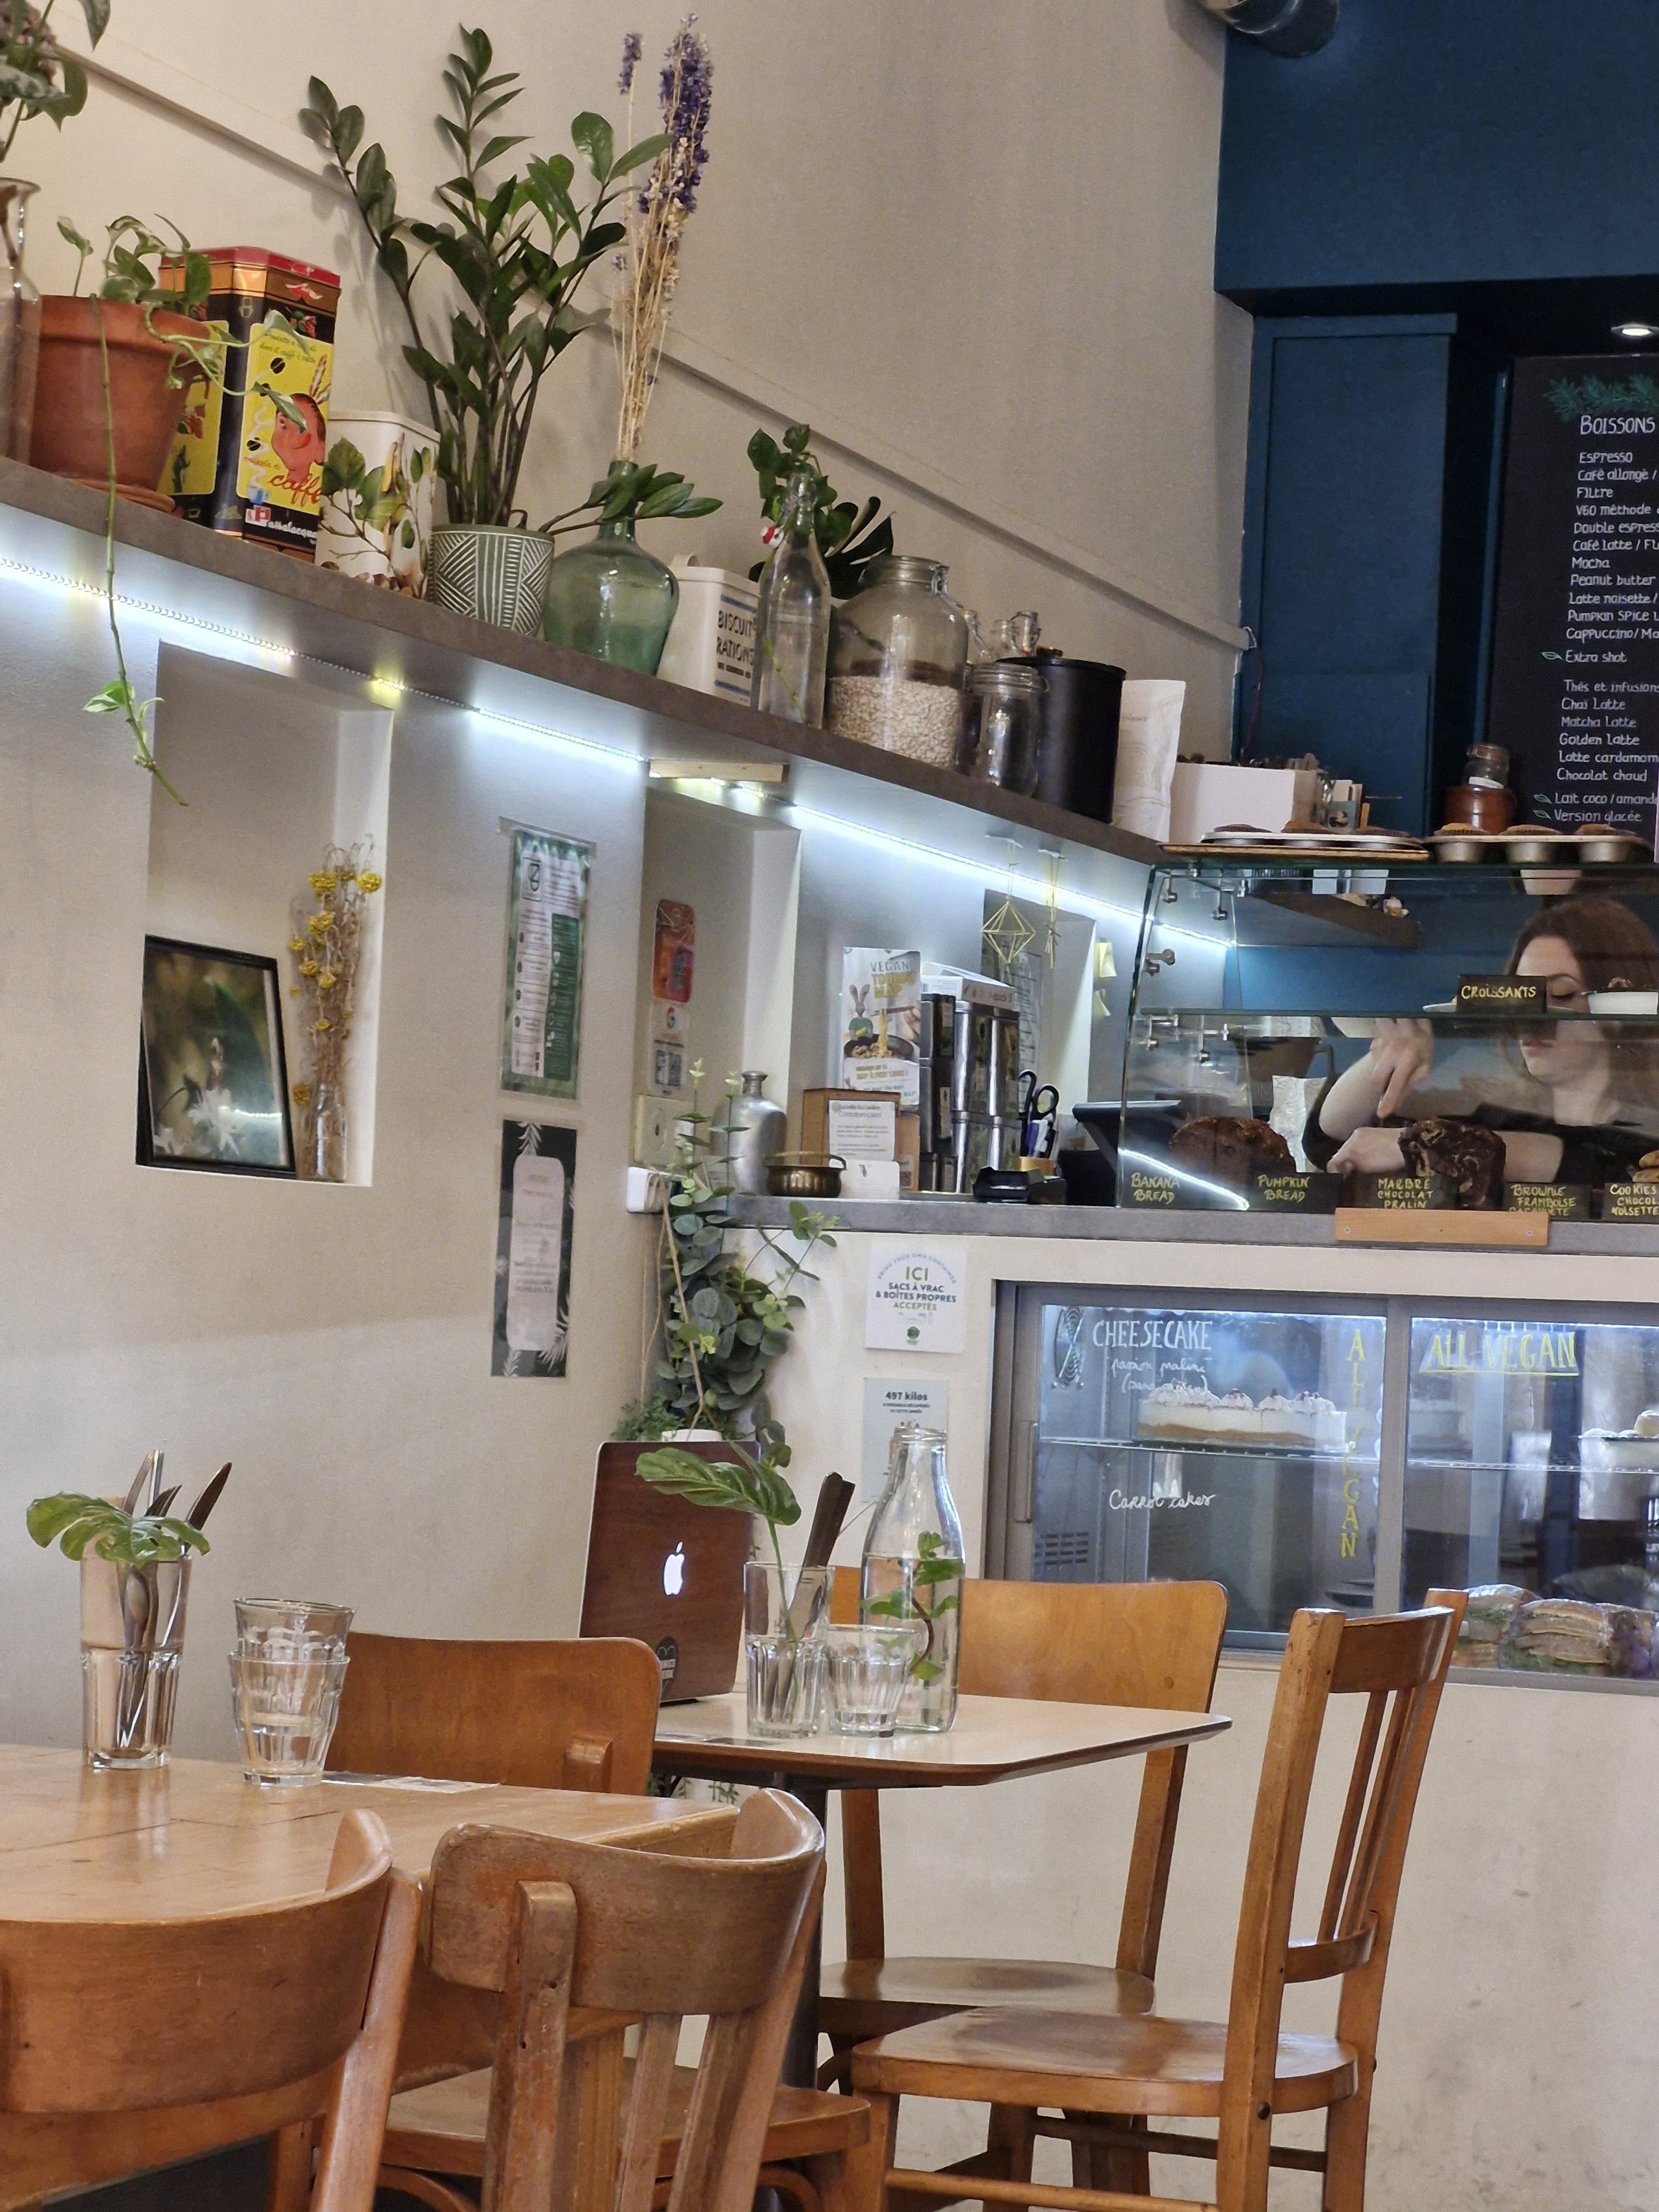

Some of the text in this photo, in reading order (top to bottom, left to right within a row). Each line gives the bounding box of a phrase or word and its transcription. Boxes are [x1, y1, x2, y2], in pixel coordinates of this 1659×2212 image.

[1580, 415, 1656, 435] BOISSONS
[1578, 468, 1605, 481] Café
[1607, 468, 1649, 483] allongé
[1577, 487, 1614, 498] Filtre
[1576, 504, 1597, 516] V60
[1600, 503, 1651, 515] méthode
[1574, 521, 1615, 534] Double
[1573, 540, 1599, 552] Café
[1572, 556, 1610, 568] Mocha
[1571, 574, 1656, 586] Peanut butter
[1566, 649, 1627, 663] Extra shot
[1563, 679, 1589, 692] Thés
[1594, 682, 1608, 692] et
[1561, 716, 1600, 727] Matcha
[1559, 733, 1602, 745] Golden
[1556, 767, 1647, 782] Chocolat chaud
[1555, 792, 1580, 804] Lait
[1583, 795, 1608, 804] coco
[1554, 808, 1642, 826] Version glacée
[870, 961, 909, 972] VEGAN
[1461, 983, 1537, 999] CROISSANTS
[1131, 1172, 1180, 1188] BANANA
[1257, 1174, 1311, 1188] PUMPKIN
[1134, 1189, 1175, 1205] BREAD
[1264, 1189, 1305, 1203] BREAD
[1378, 1190, 1434, 1199] CHOCOLAT
[1384, 1199, 1427, 1209] PRALIN
[1516, 1197, 1576, 1207] FRAMBOISE
[906, 1266, 928, 1281] ICI
[912, 1282, 918, 1291] À
[920, 1284, 944, 1292] VRAC
[916, 1293, 957, 1302] PROPRES
[1093, 1319, 1213, 1351] CHEESECAKE
[1426, 1332, 1575, 1370] ALL VEGAN
[886, 1391, 927, 1401] 497 kilos
